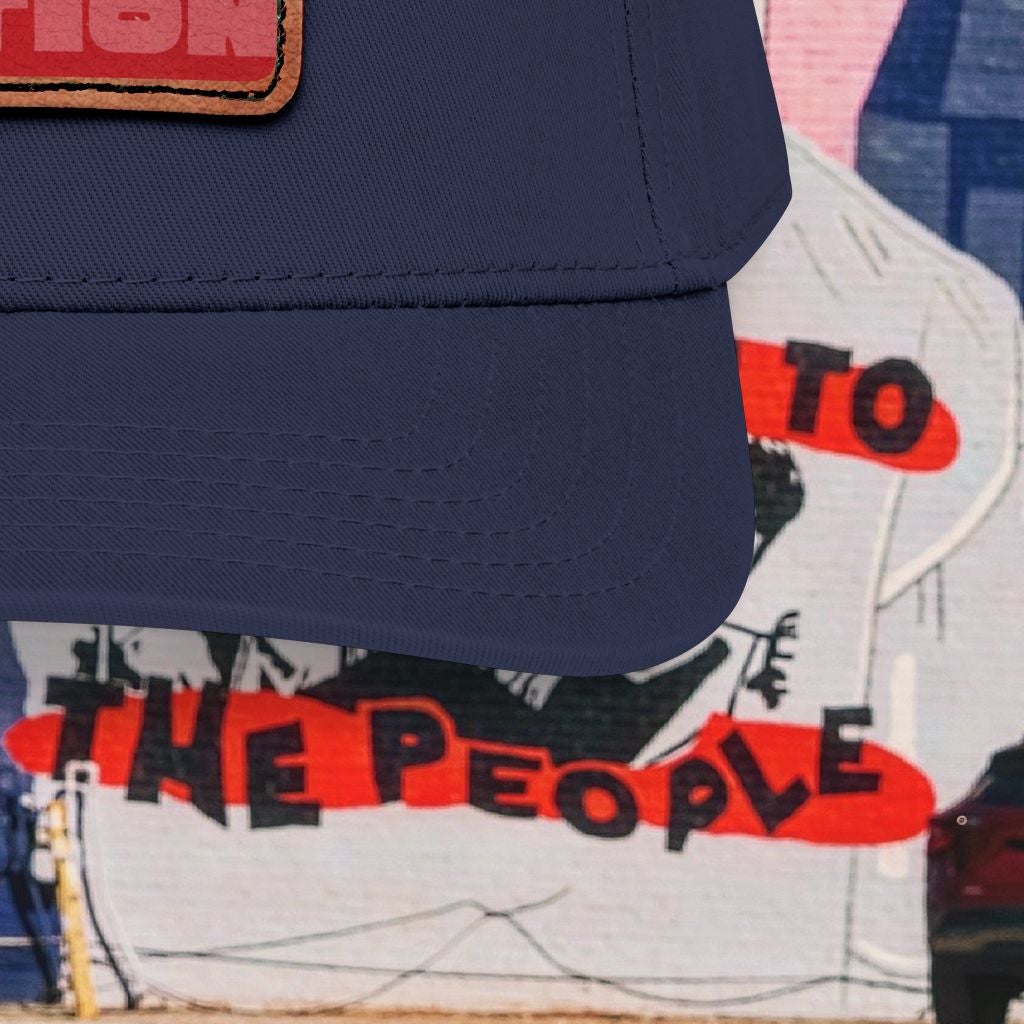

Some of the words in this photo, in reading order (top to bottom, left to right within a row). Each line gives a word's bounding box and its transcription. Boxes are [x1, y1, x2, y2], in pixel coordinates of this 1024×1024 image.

[785, 339, 933, 455] TO
[45, 675, 321, 829] THE
[368, 706, 882, 852] PEOPLE
